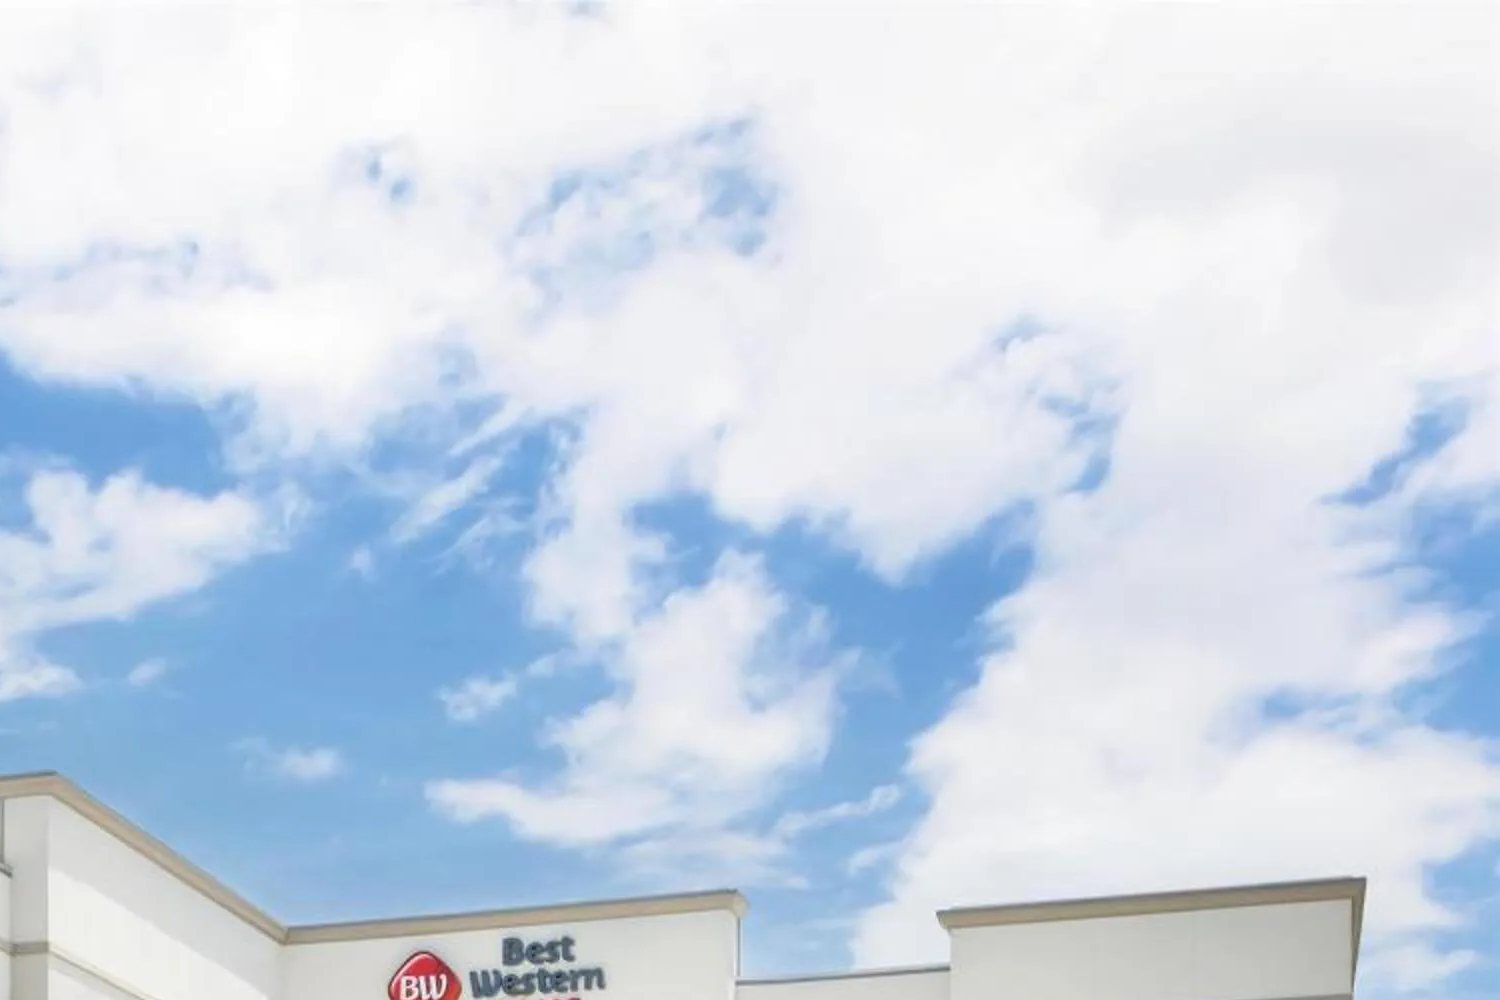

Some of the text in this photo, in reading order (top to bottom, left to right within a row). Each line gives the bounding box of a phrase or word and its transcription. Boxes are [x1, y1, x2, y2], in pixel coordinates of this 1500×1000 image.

[502, 936, 575, 966] Best
[400, 974, 447, 1000] BW
[469, 966, 606, 998] Western
